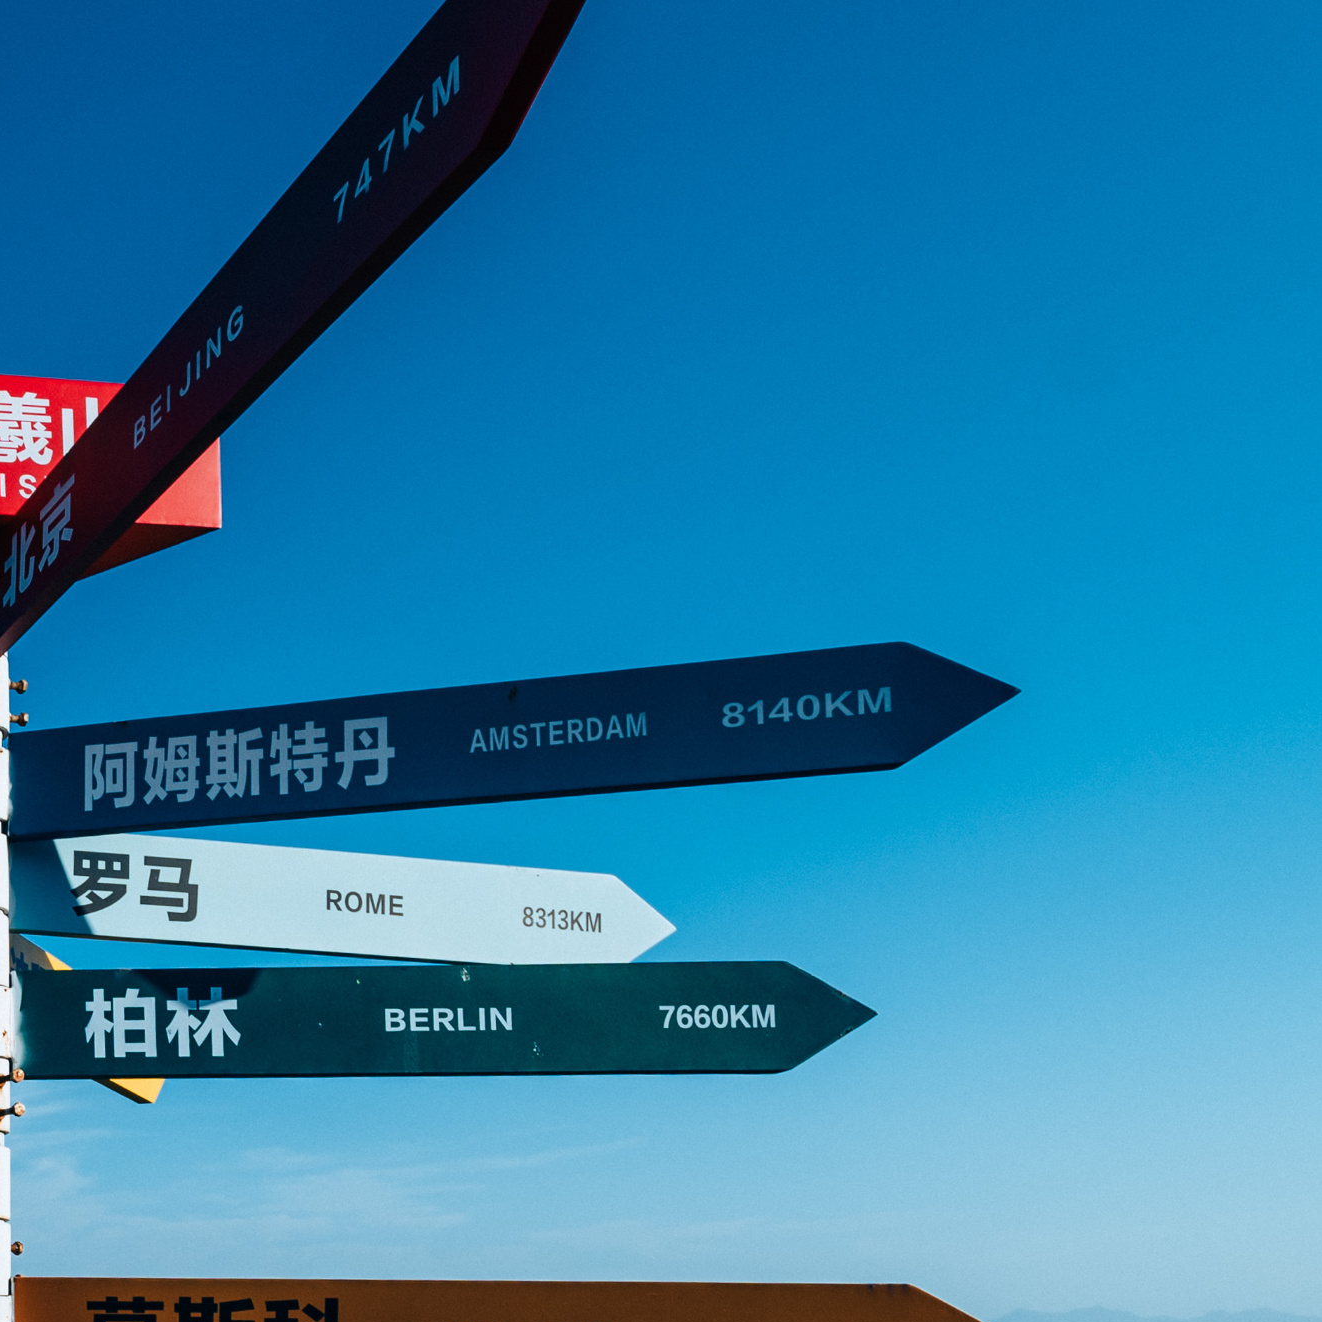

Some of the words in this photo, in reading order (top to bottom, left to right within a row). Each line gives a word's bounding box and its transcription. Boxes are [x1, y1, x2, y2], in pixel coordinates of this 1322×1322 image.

[2, 472, 76, 609] 北京
[131, 303, 246, 451] BEIJING
[331, 54, 462, 226] 747KM
[82, 715, 396, 814] 阿姆斯特丹
[469, 712, 648, 754] AMSTERDAM
[721, 685, 893, 730] 8140KM
[70, 848, 200, 923] 罗马
[325, 888, 405, 917] ROME
[521, 905, 603, 934] 8313KM
[84, 986, 242, 1059] 柏林
[383, 1006, 514, 1033] BERLIN
[658, 1003, 777, 1030] 7660KM
